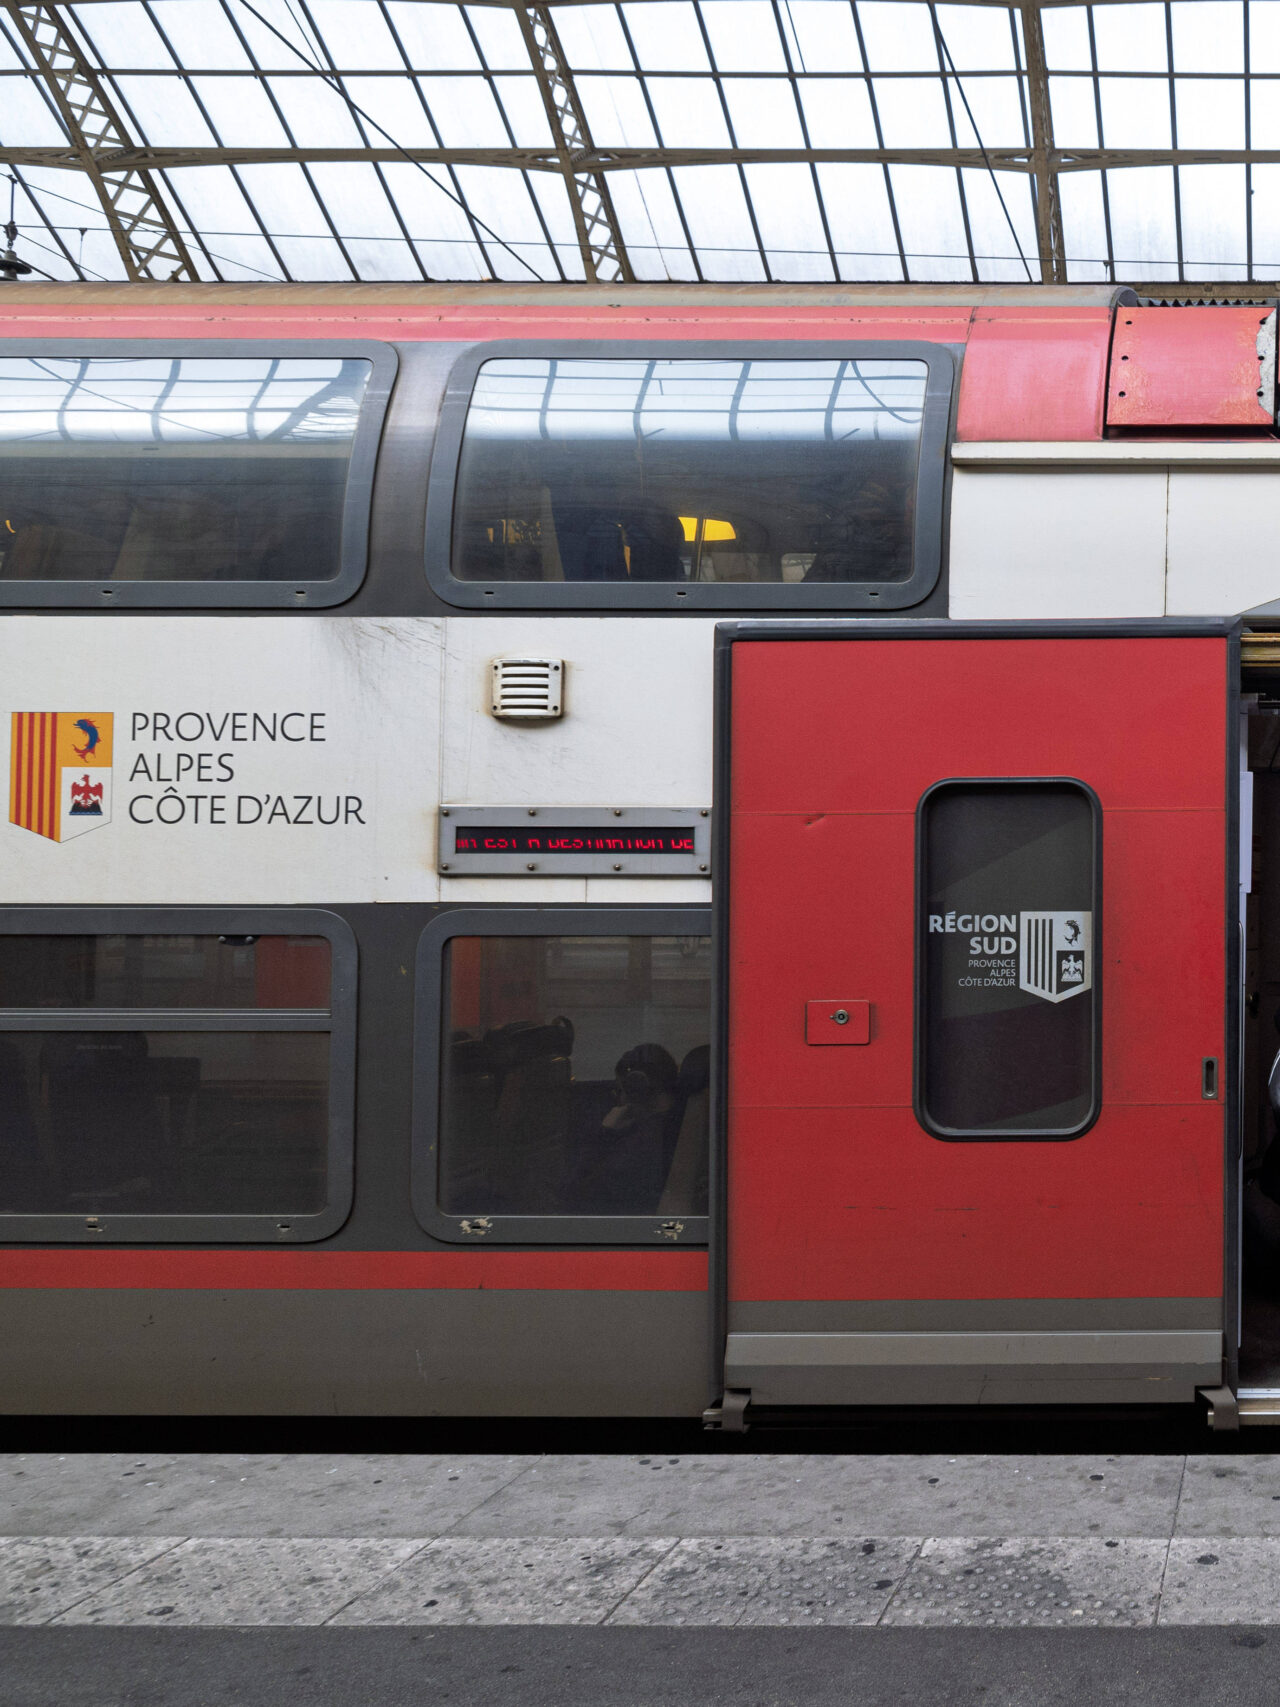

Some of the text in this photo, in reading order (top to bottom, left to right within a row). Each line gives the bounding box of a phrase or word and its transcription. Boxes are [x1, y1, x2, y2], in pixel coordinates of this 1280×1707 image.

[131, 712, 326, 742] PROVENCE
[129, 753, 235, 782] ALPES
[129, 786, 366, 825] CÔTE D'AZUR
[929, 911, 1017, 933] RÉGION
[969, 936, 1017, 955] SUD
[968, 959, 1016, 968] PROVENCE
[989, 968, 1016, 977] ALPES
[958, 976, 1016, 987] CÔTE D'AZUR
